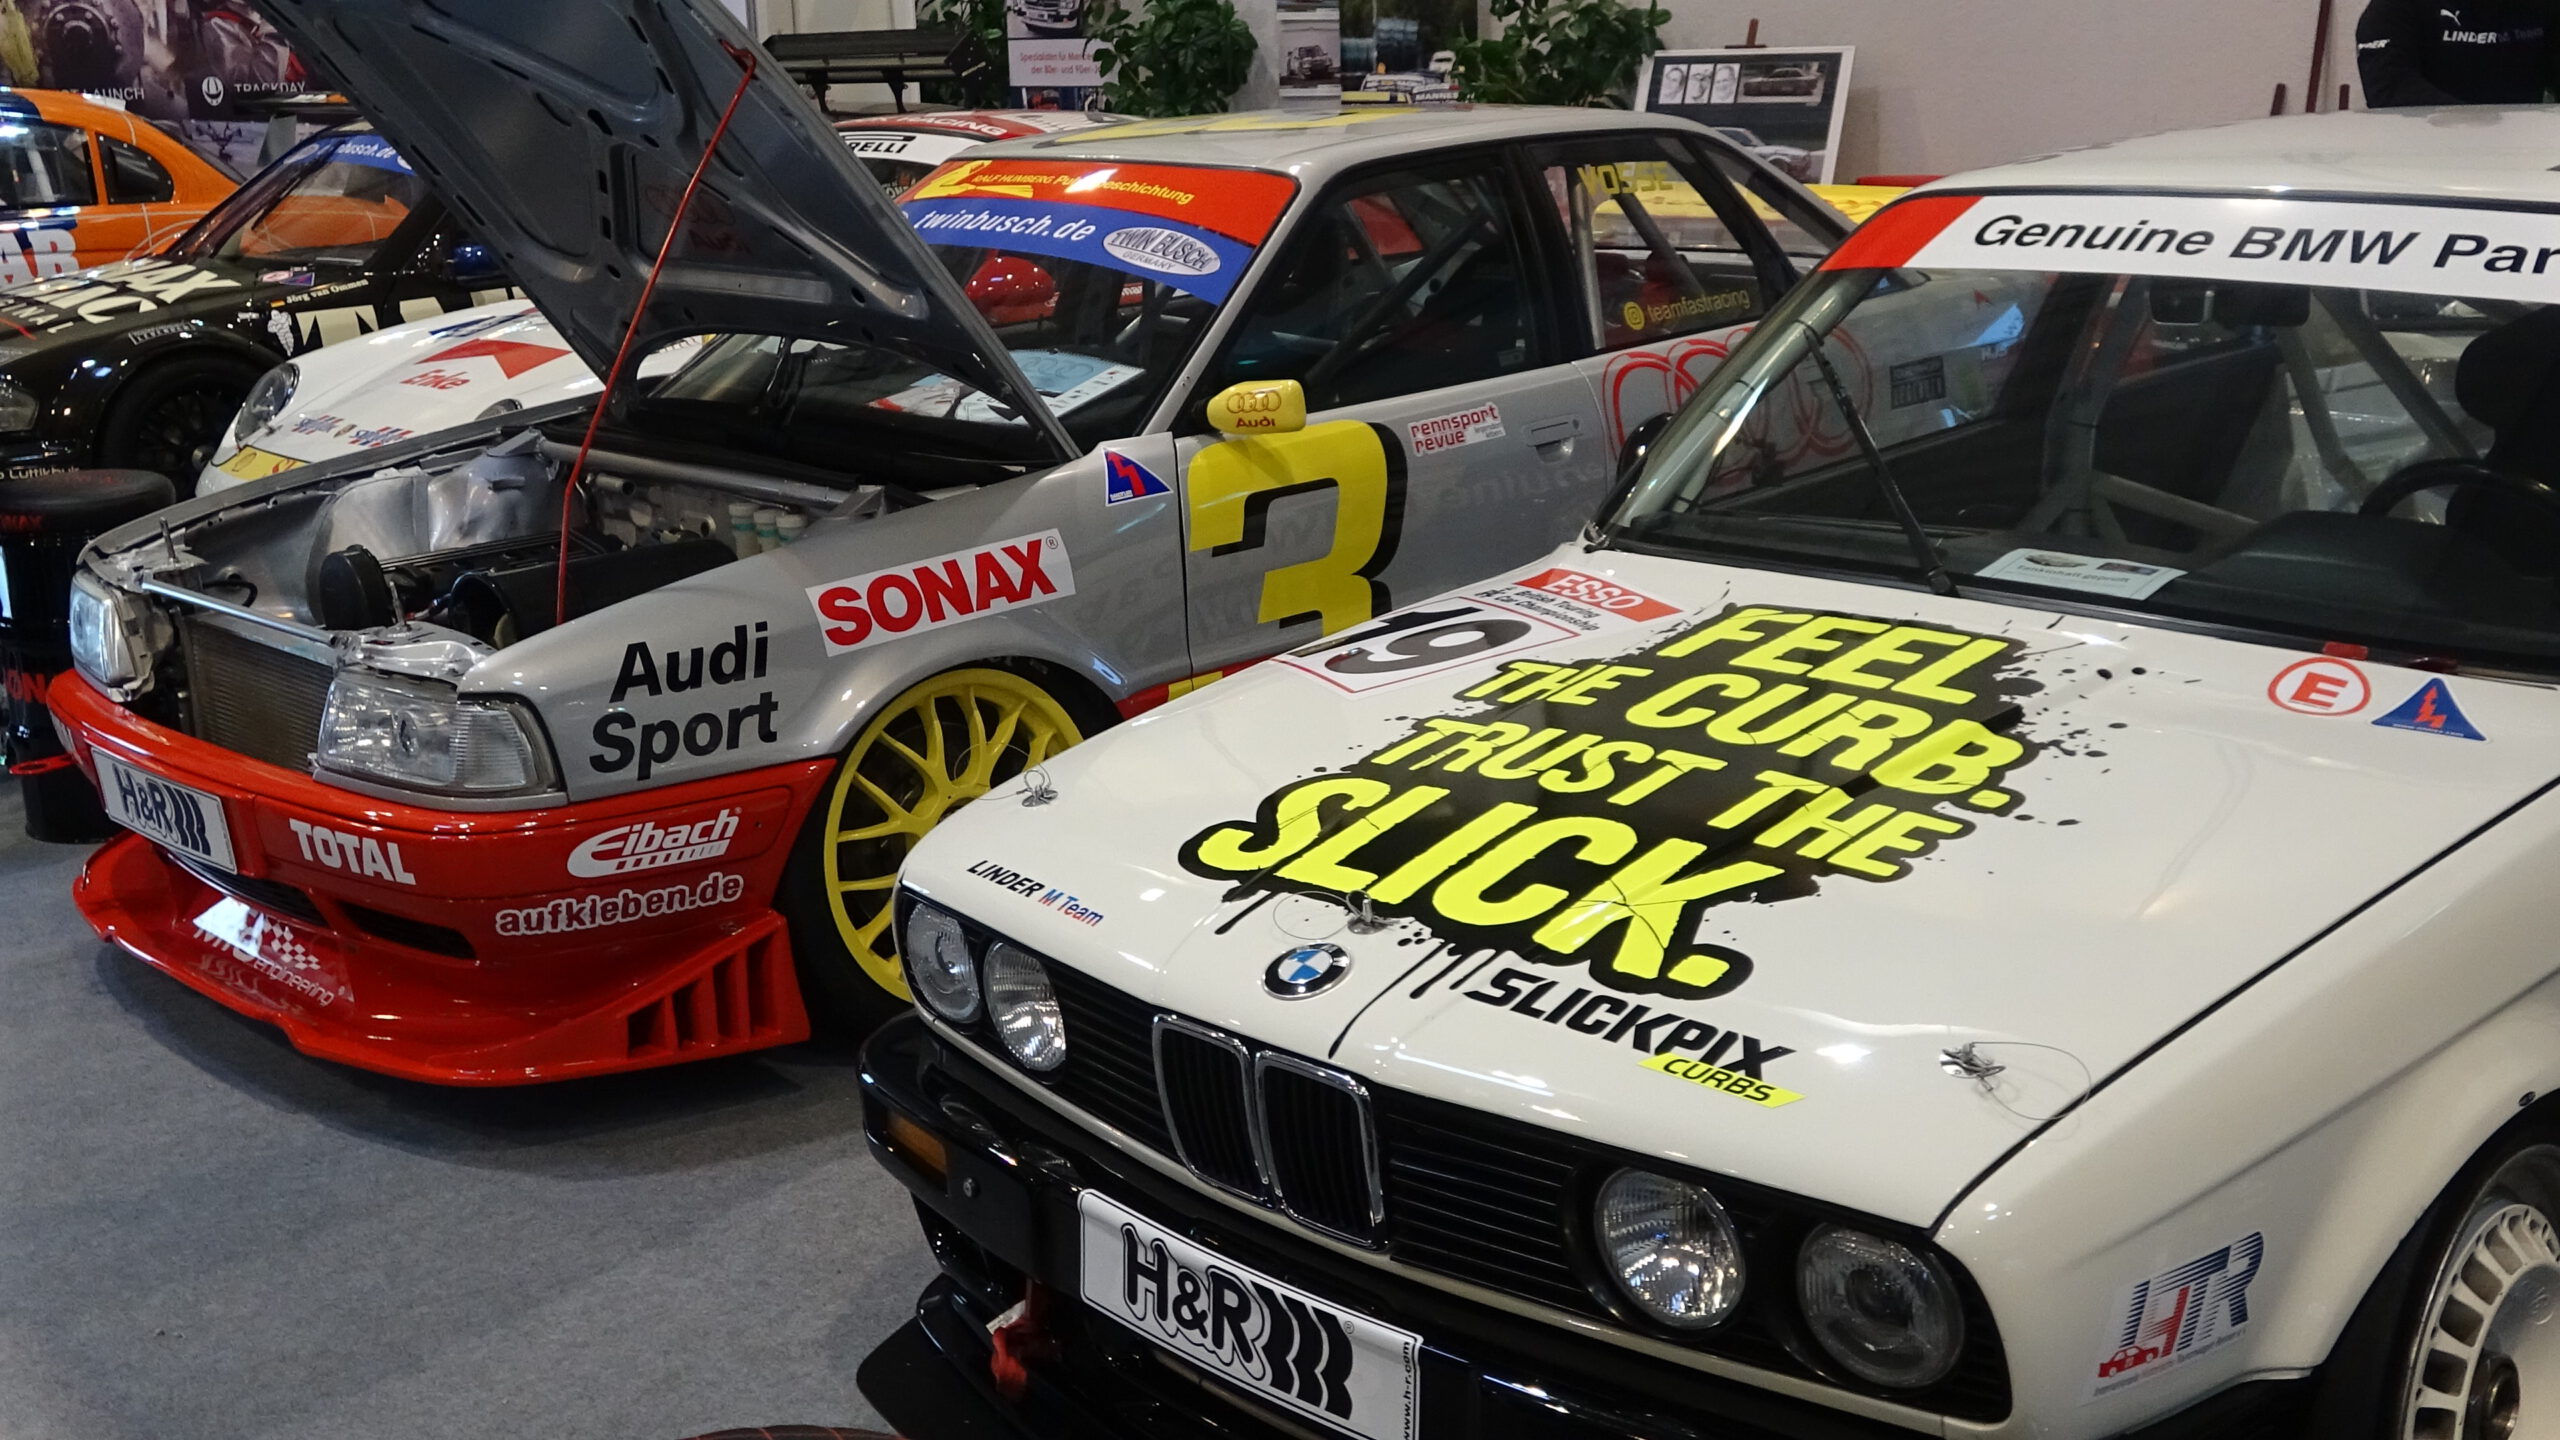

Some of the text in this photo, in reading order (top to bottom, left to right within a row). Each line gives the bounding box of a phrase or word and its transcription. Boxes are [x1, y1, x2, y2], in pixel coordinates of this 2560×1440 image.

[2443, 30, 2497, 44] LINDER
[971, 175, 1000, 184] RALF
[999, 174, 1053, 185] HUMBERG
[914, 210, 1096, 241] twinbusch.de
[1110, 229, 1217, 270] TWIN BUSCH
[1973, 213, 2560, 275] Genuine BMW Par
[1122, 251, 1176, 271] GERMANY
[1646, 289, 1750, 325] teamfastracing
[1236, 416, 1276, 428] Audi
[1410, 404, 1499, 438] rennsport
[1414, 429, 1466, 454] revue
[1187, 420, 1396, 638] 3
[817, 538, 1058, 647] SONAX
[1541, 574, 1645, 610] ESSO
[607, 620, 769, 704] Audi
[1286, 606, 1532, 675] 19
[1655, 607, 2009, 706] FEEL
[2289, 671, 2349, 709] E
[588, 691, 780, 782] Sport
[1463, 661, 2025, 809] THE CURB.
[1371, 718, 1964, 877] TRUST THE
[288, 817, 417, 886] TOTAL
[567, 808, 741, 878] Eibach
[495, 871, 744, 936] aufkleben.de
[965, 859, 1105, 928] LINDER M Team
[1197, 777, 1785, 988] SLICK.
[253, 958, 335, 1007] engineering
[1462, 967, 1797, 1082] SLICKPIX
[1662, 1058, 1777, 1102] CURBS
